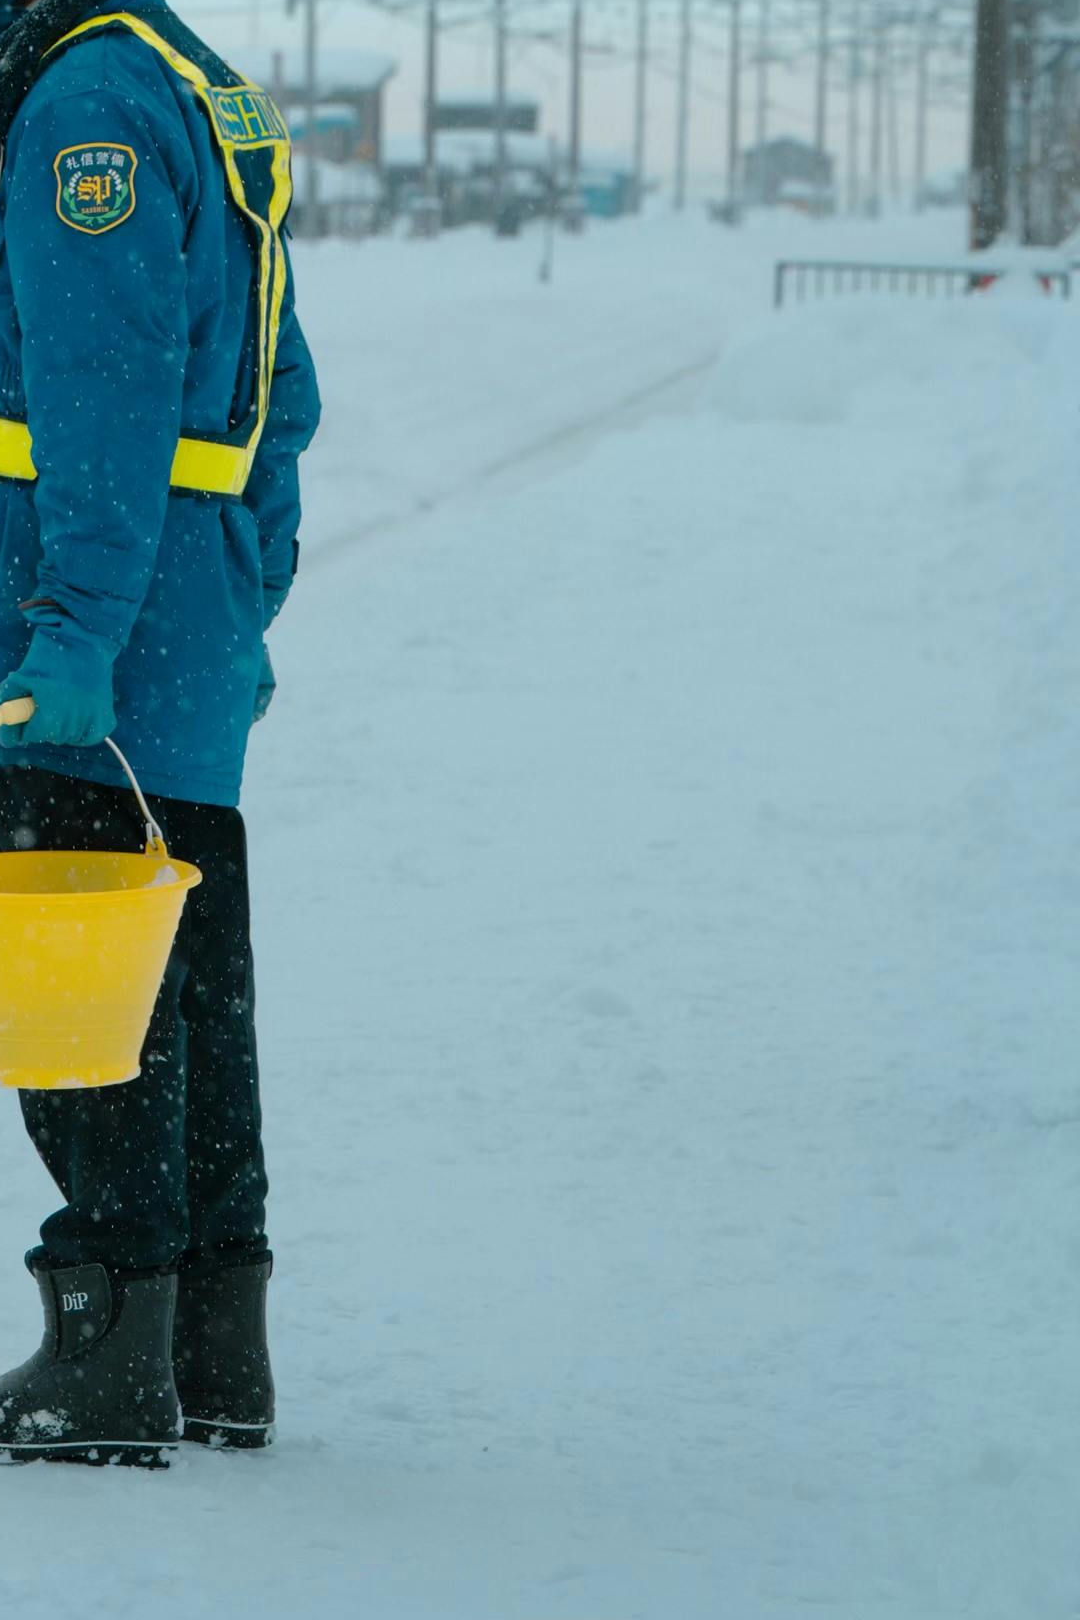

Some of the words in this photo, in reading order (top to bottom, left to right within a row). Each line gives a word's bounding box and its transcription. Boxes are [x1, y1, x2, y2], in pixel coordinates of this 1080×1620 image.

[66, 151, 125, 170] 札信警備
[62, 1292, 88, 1311] DiP
